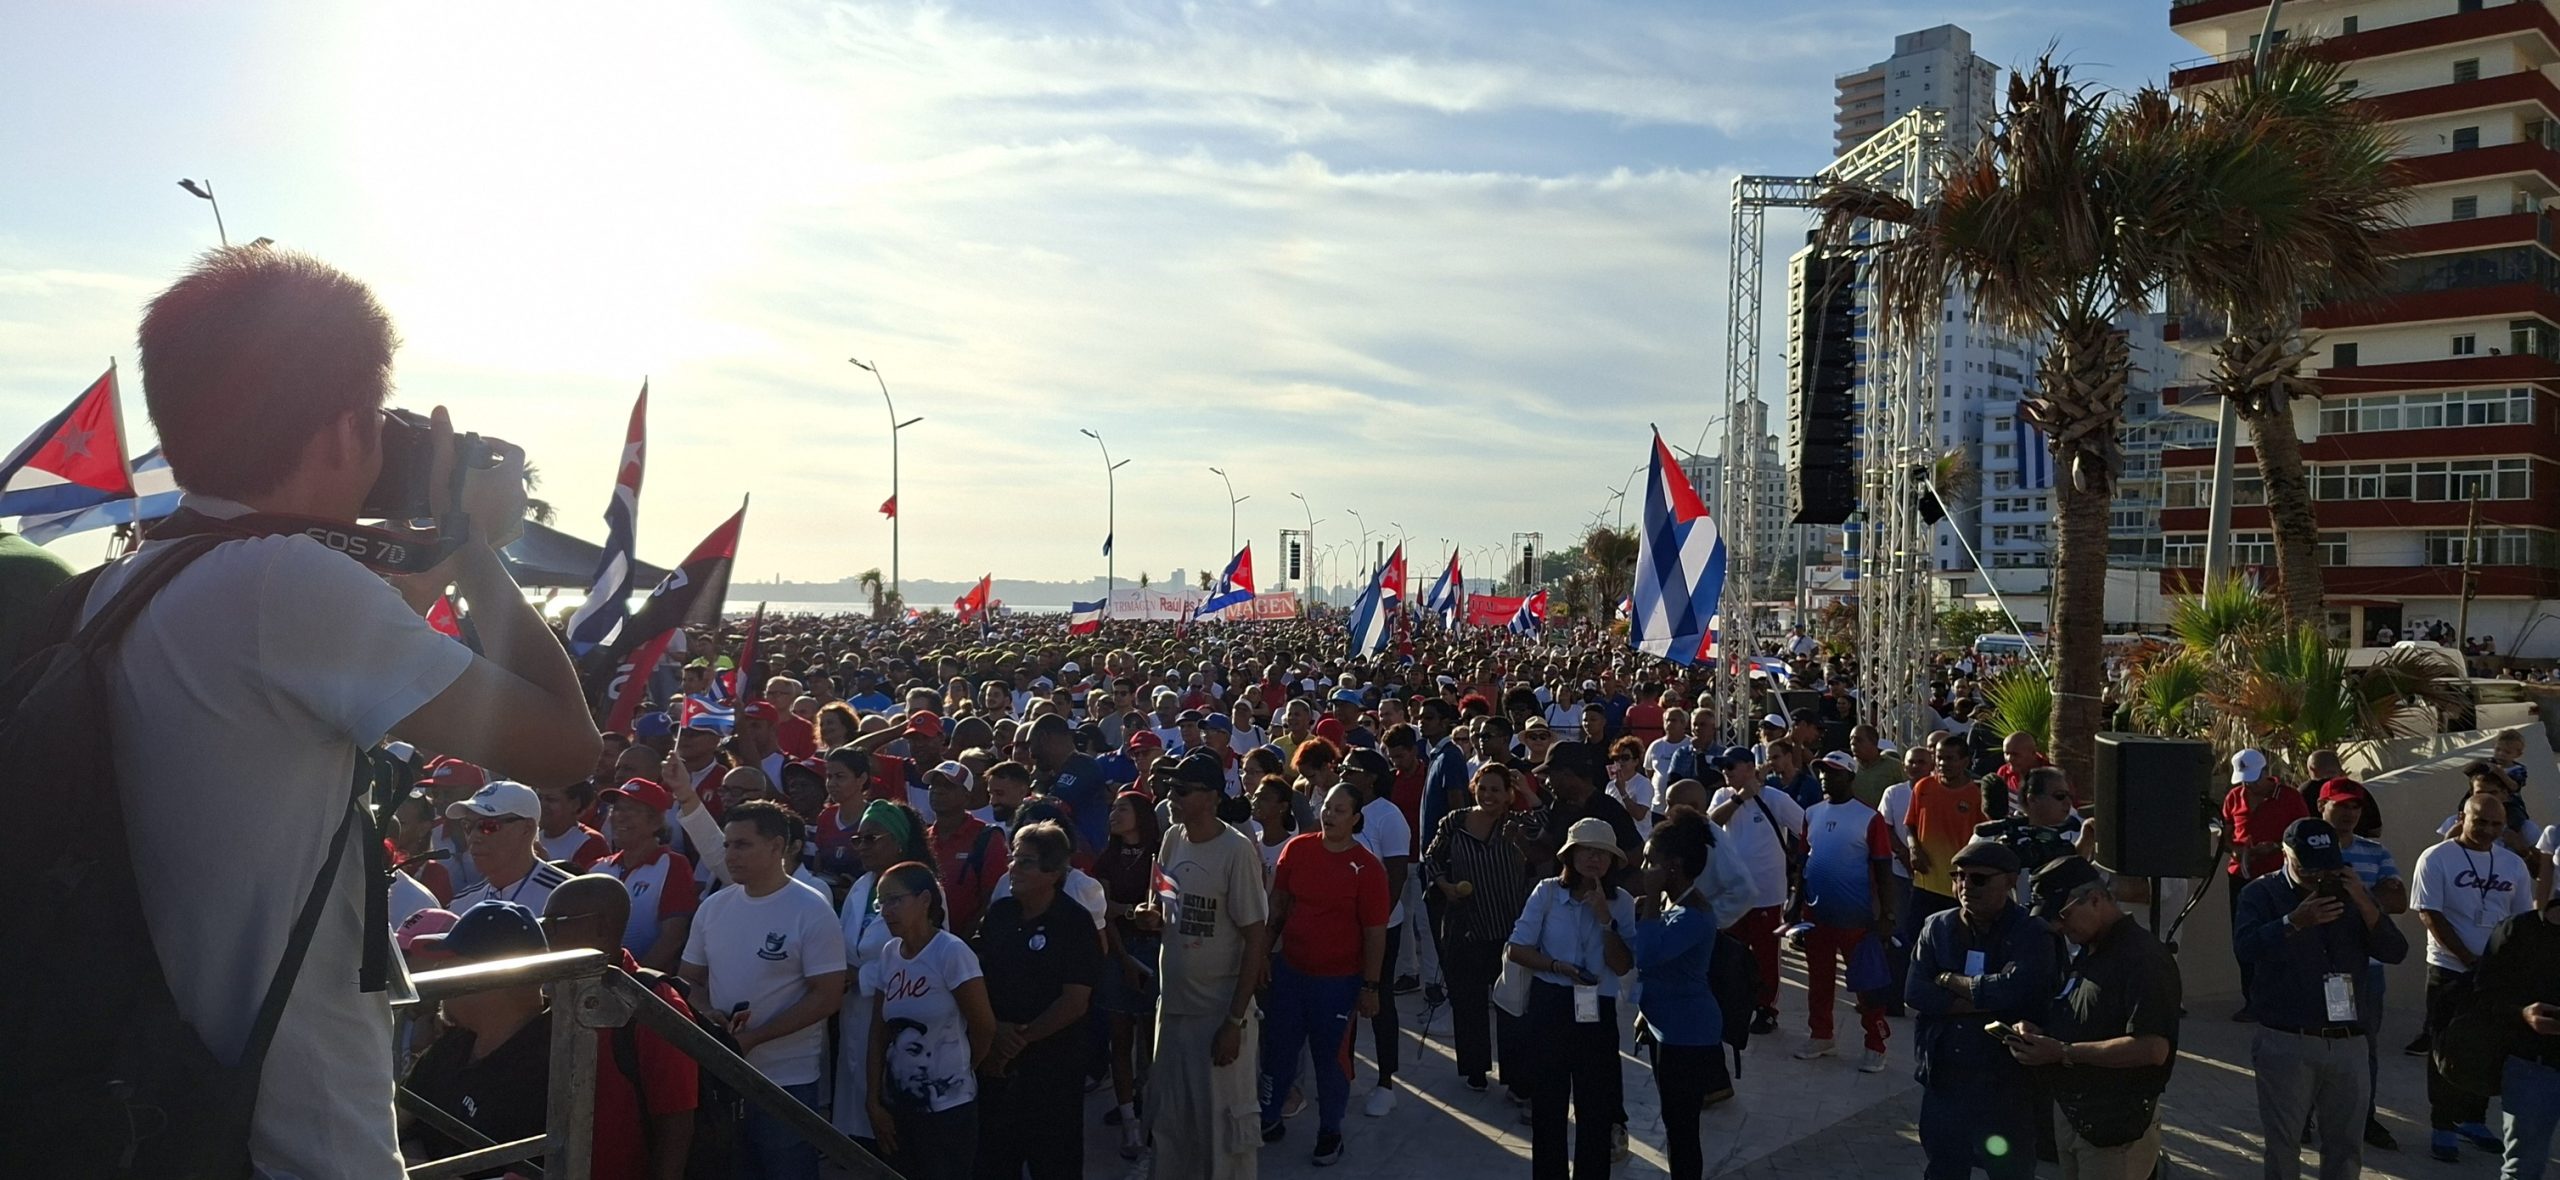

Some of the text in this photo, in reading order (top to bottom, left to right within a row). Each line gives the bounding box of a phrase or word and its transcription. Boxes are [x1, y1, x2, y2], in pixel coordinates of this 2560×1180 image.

[306, 528, 406, 563] EOS 7D
[1160, 597, 1181, 612] Raúl
[2307, 833, 2331, 846] CNN
[2454, 870, 2512, 892] Cuba
[887, 969, 930, 1001] Che
